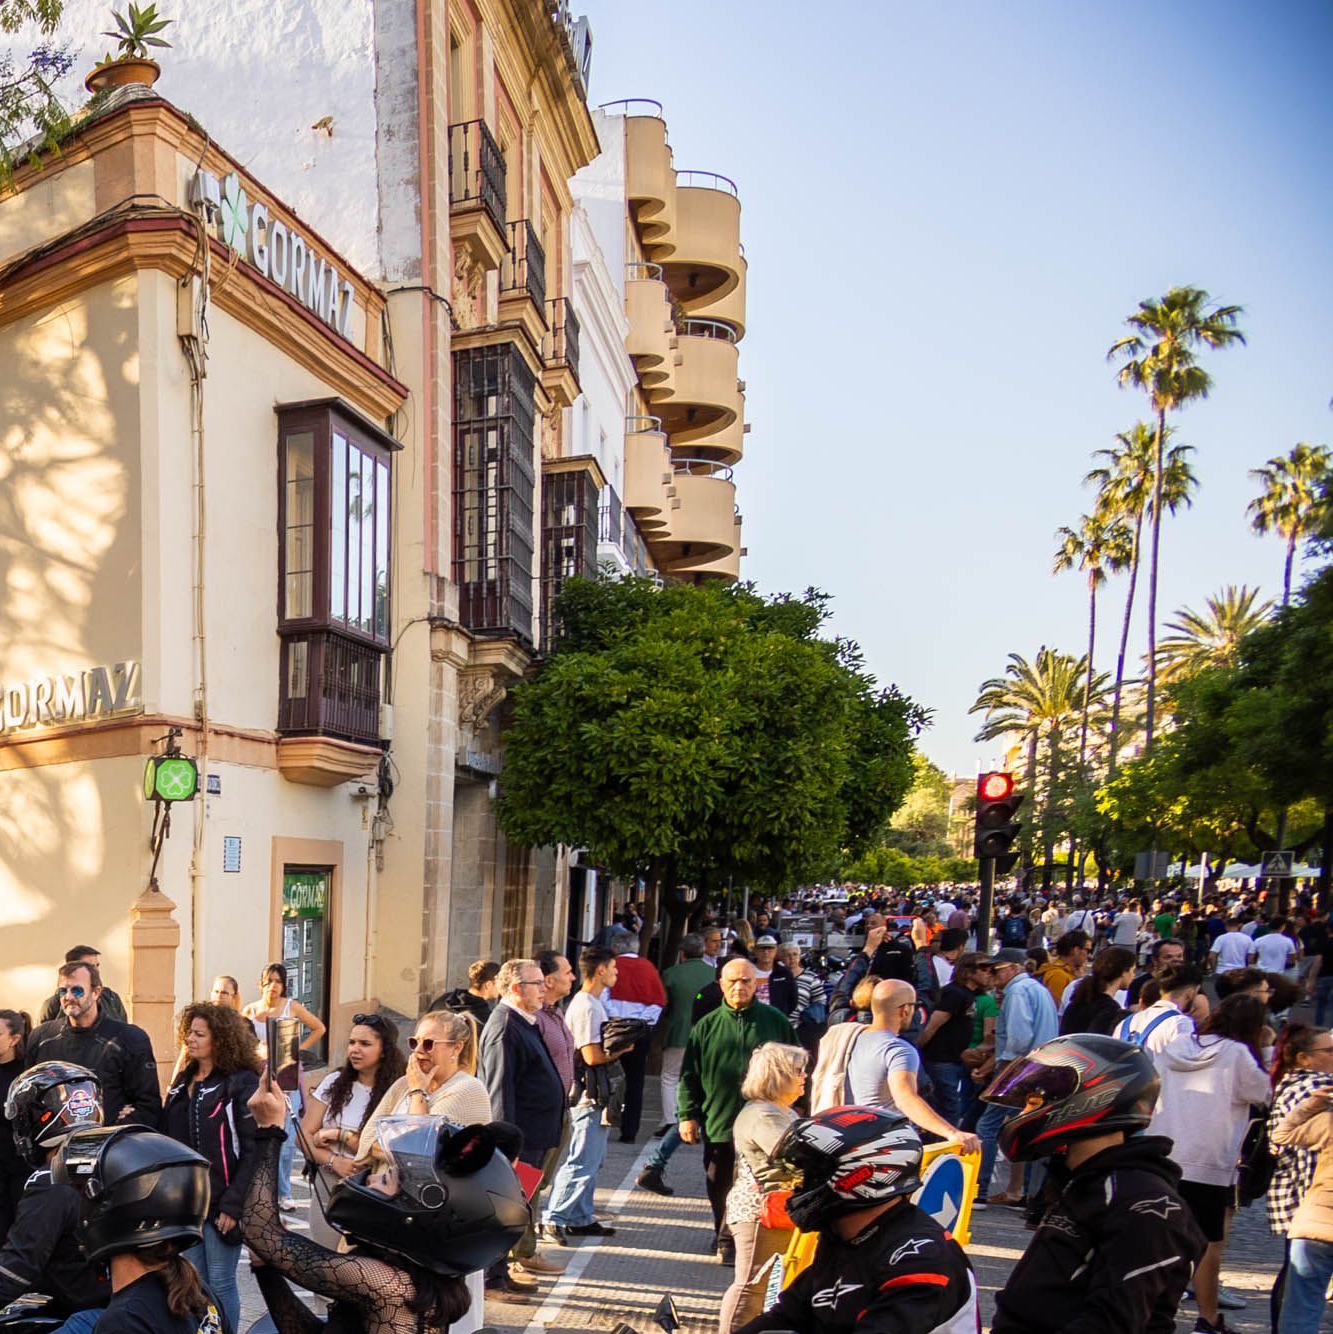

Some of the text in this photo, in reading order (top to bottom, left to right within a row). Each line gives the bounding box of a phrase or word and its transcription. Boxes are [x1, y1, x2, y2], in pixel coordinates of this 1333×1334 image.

[252, 203, 354, 338] GORMAZ
[290, 884, 325, 909] GORMAZ
[839, 1167, 871, 1188] SHOEI
